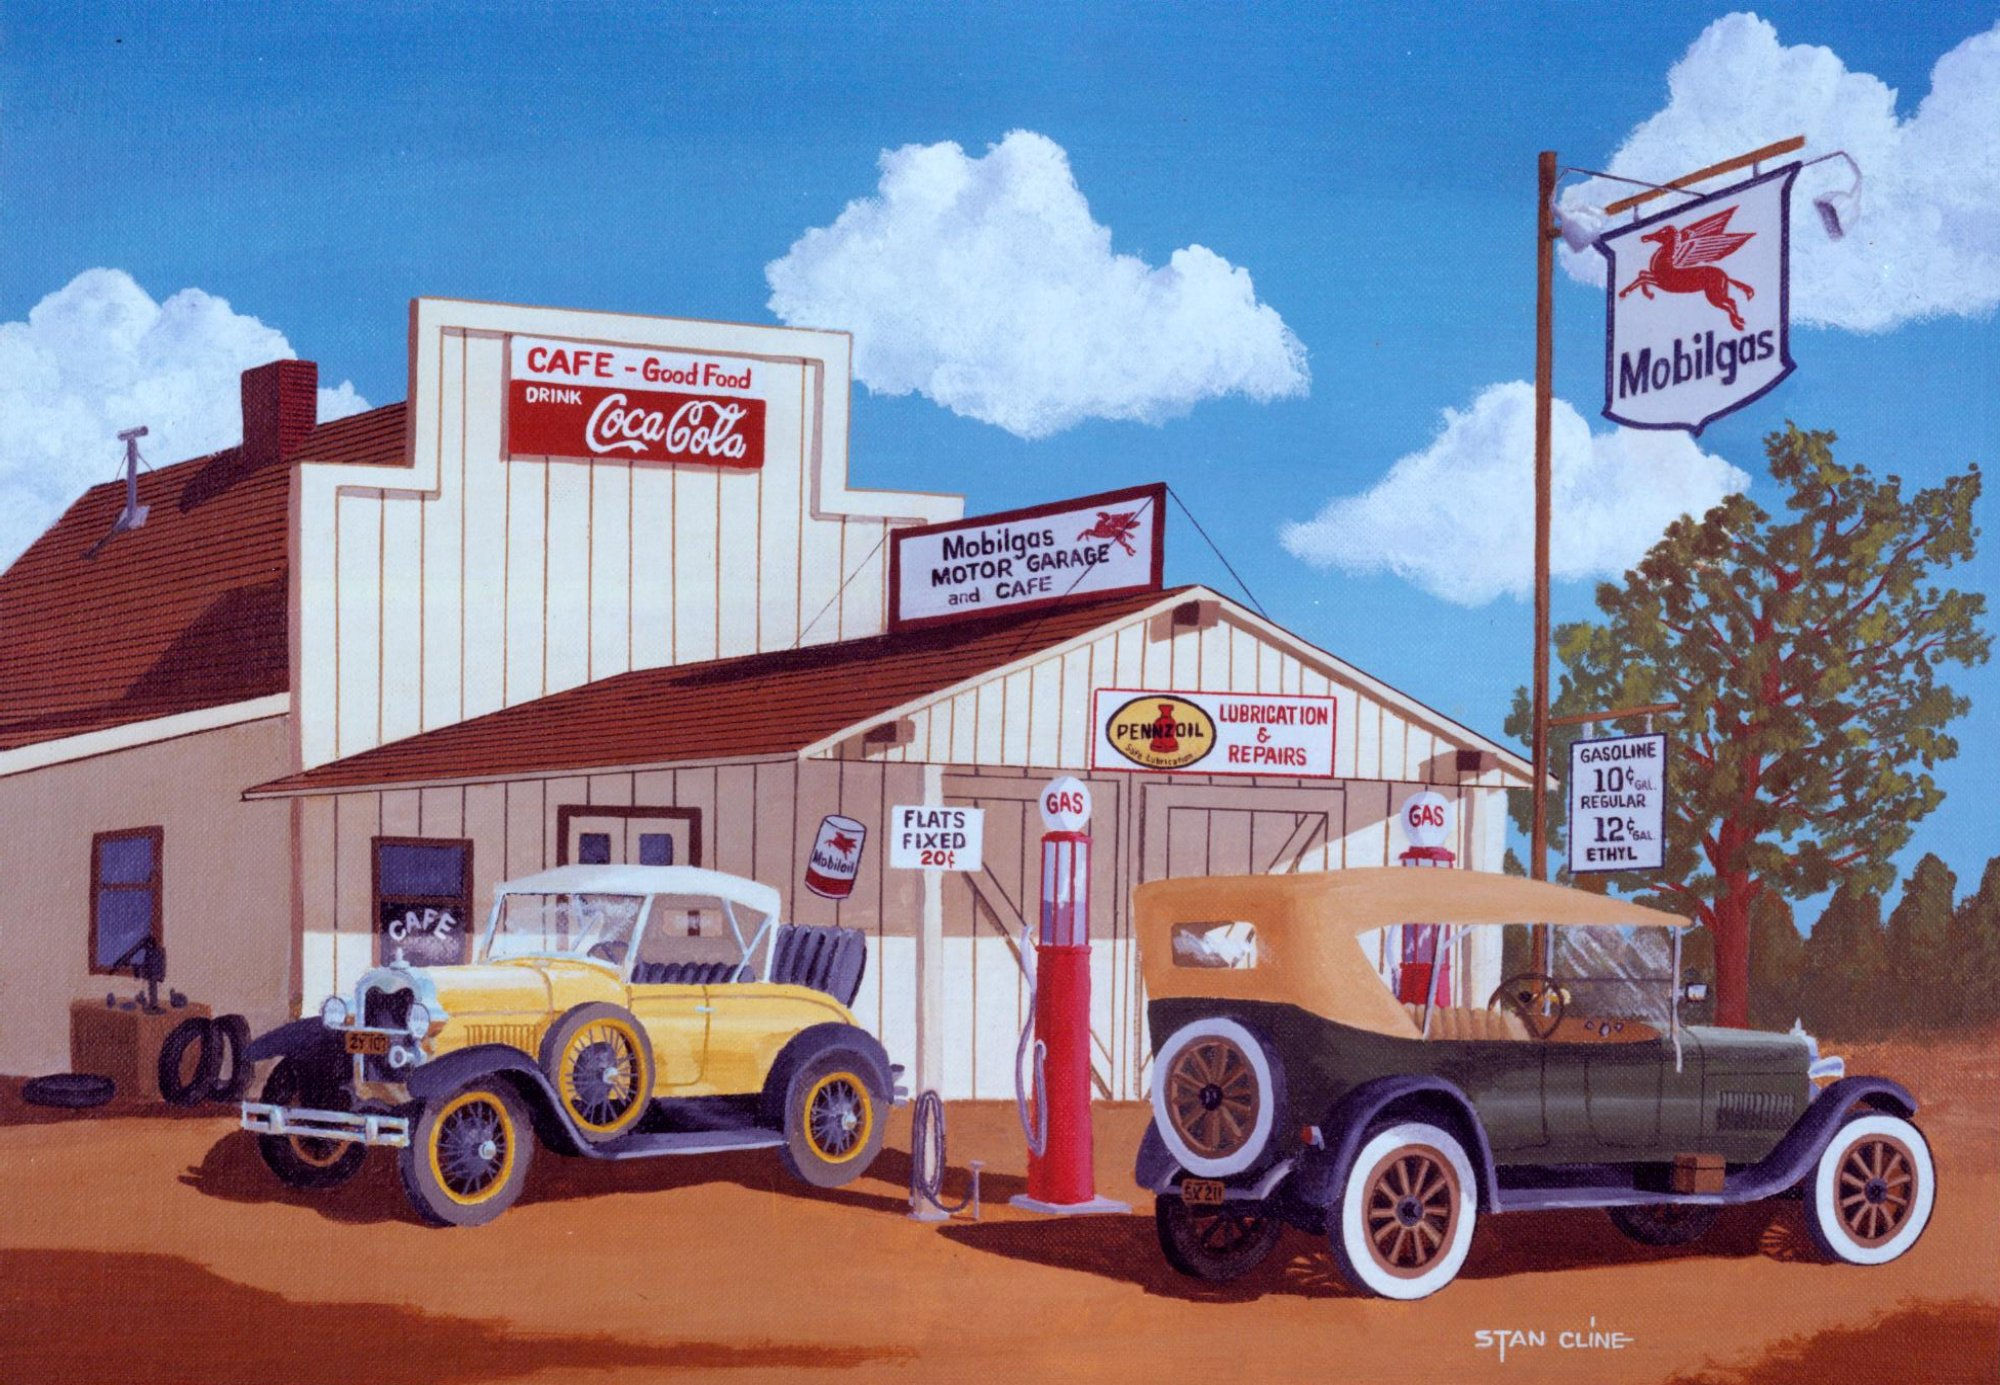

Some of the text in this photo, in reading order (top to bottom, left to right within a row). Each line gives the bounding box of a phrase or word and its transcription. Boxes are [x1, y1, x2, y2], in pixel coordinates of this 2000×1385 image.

[527, 347, 615, 377] CAFE
[642, 357, 698, 386] Good
[703, 363, 752, 390] Food
[1619, 330, 1775, 399] Mobilgas
[525, 386, 583, 405] DRINK
[942, 528, 1055, 561] Mobilgas
[931, 543, 1111, 587] MOTOR GARAGE
[948, 575, 1053, 605] and CAFE
[1219, 704, 1329, 726] LUBRICATION
[1117, 722, 1204, 740] PENNZOIL
[1256, 727, 1271, 743] &
[1228, 745, 1307, 767] REPAIRS
[1580, 742, 1657, 763] GASOLINE
[1593, 766, 1634, 793] 10¢
[1046, 791, 1085, 815] GAS
[1581, 794, 1646, 809] REGULAR
[903, 810, 965, 829] FLATS
[1409, 804, 1444, 827] GAS
[1593, 816, 1635, 842] 12¢
[903, 832, 967, 850] FIXED
[812, 849, 855, 873] Mobiloil
[920, 850, 955, 868] 20¢
[1586, 846, 1638, 861] ETHYL
[388, 908, 457, 941] CAFE
[1474, 1315, 1634, 1363] STAN CLINE
